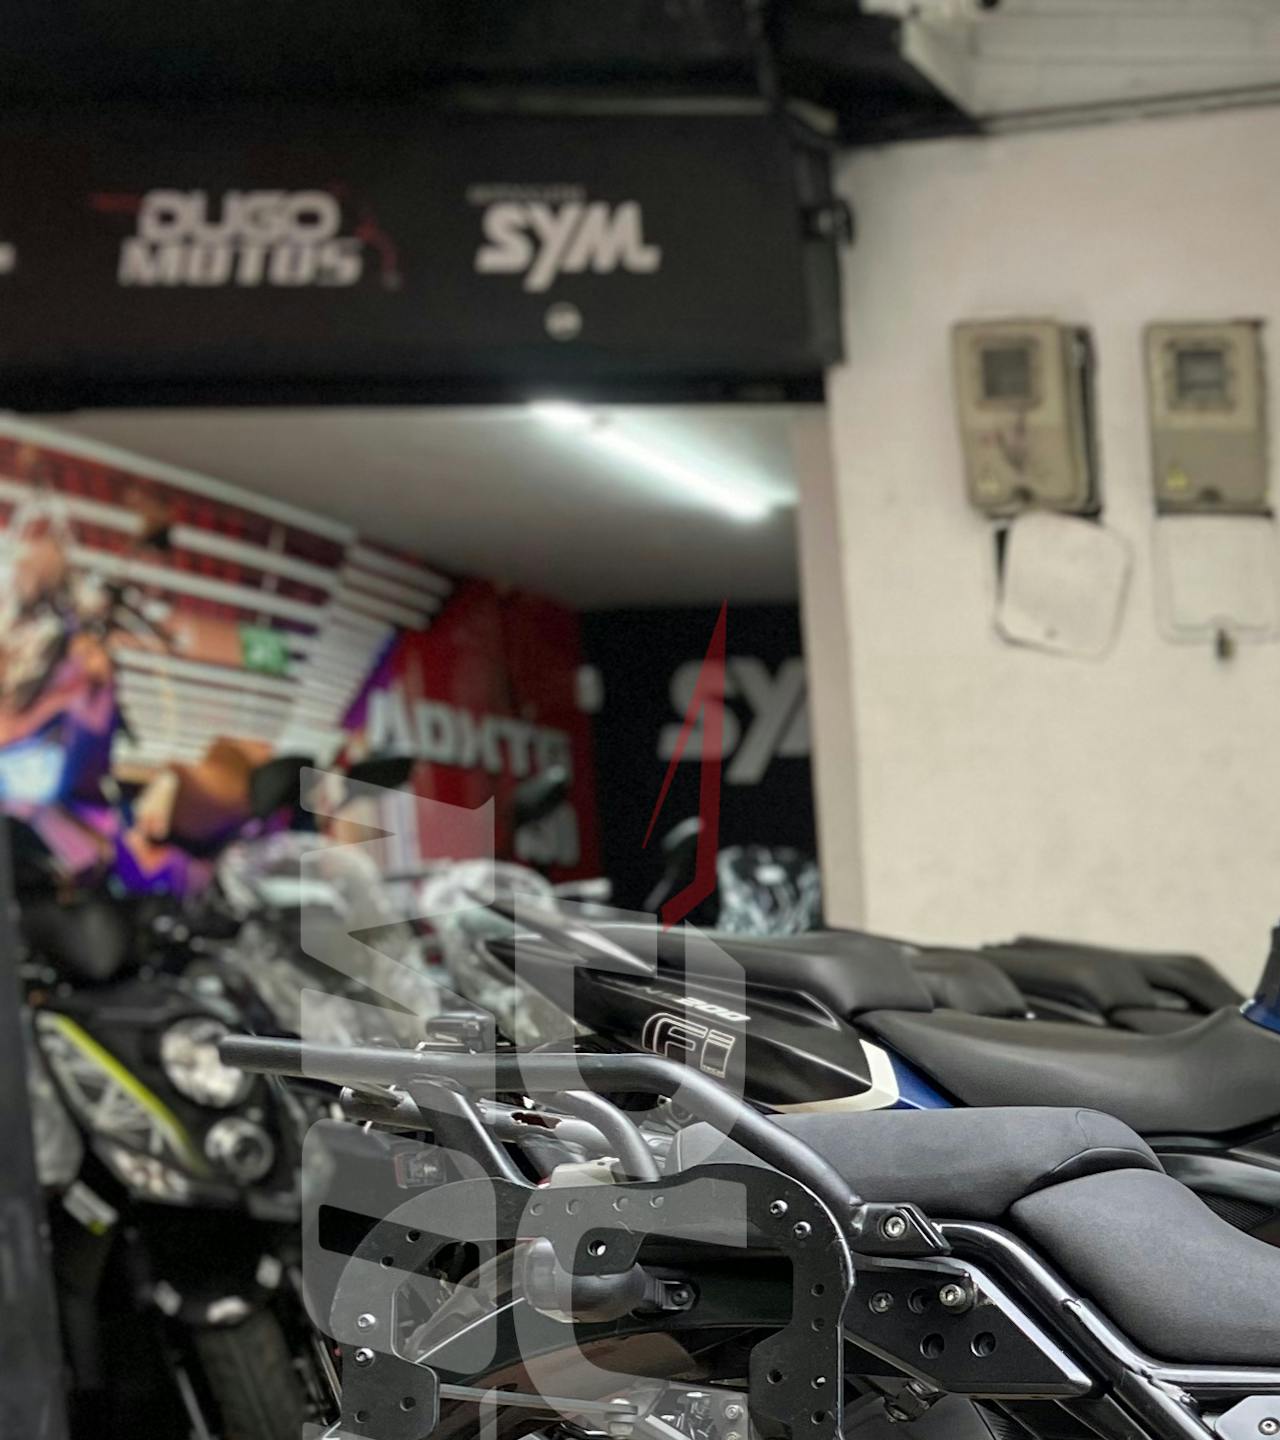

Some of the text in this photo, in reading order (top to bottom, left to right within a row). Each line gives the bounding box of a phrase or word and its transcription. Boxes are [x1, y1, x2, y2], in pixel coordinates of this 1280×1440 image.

[137, 187, 343, 242] DUGO
[117, 236, 364, 289] MOTOS
[474, 200, 662, 293] SYM
